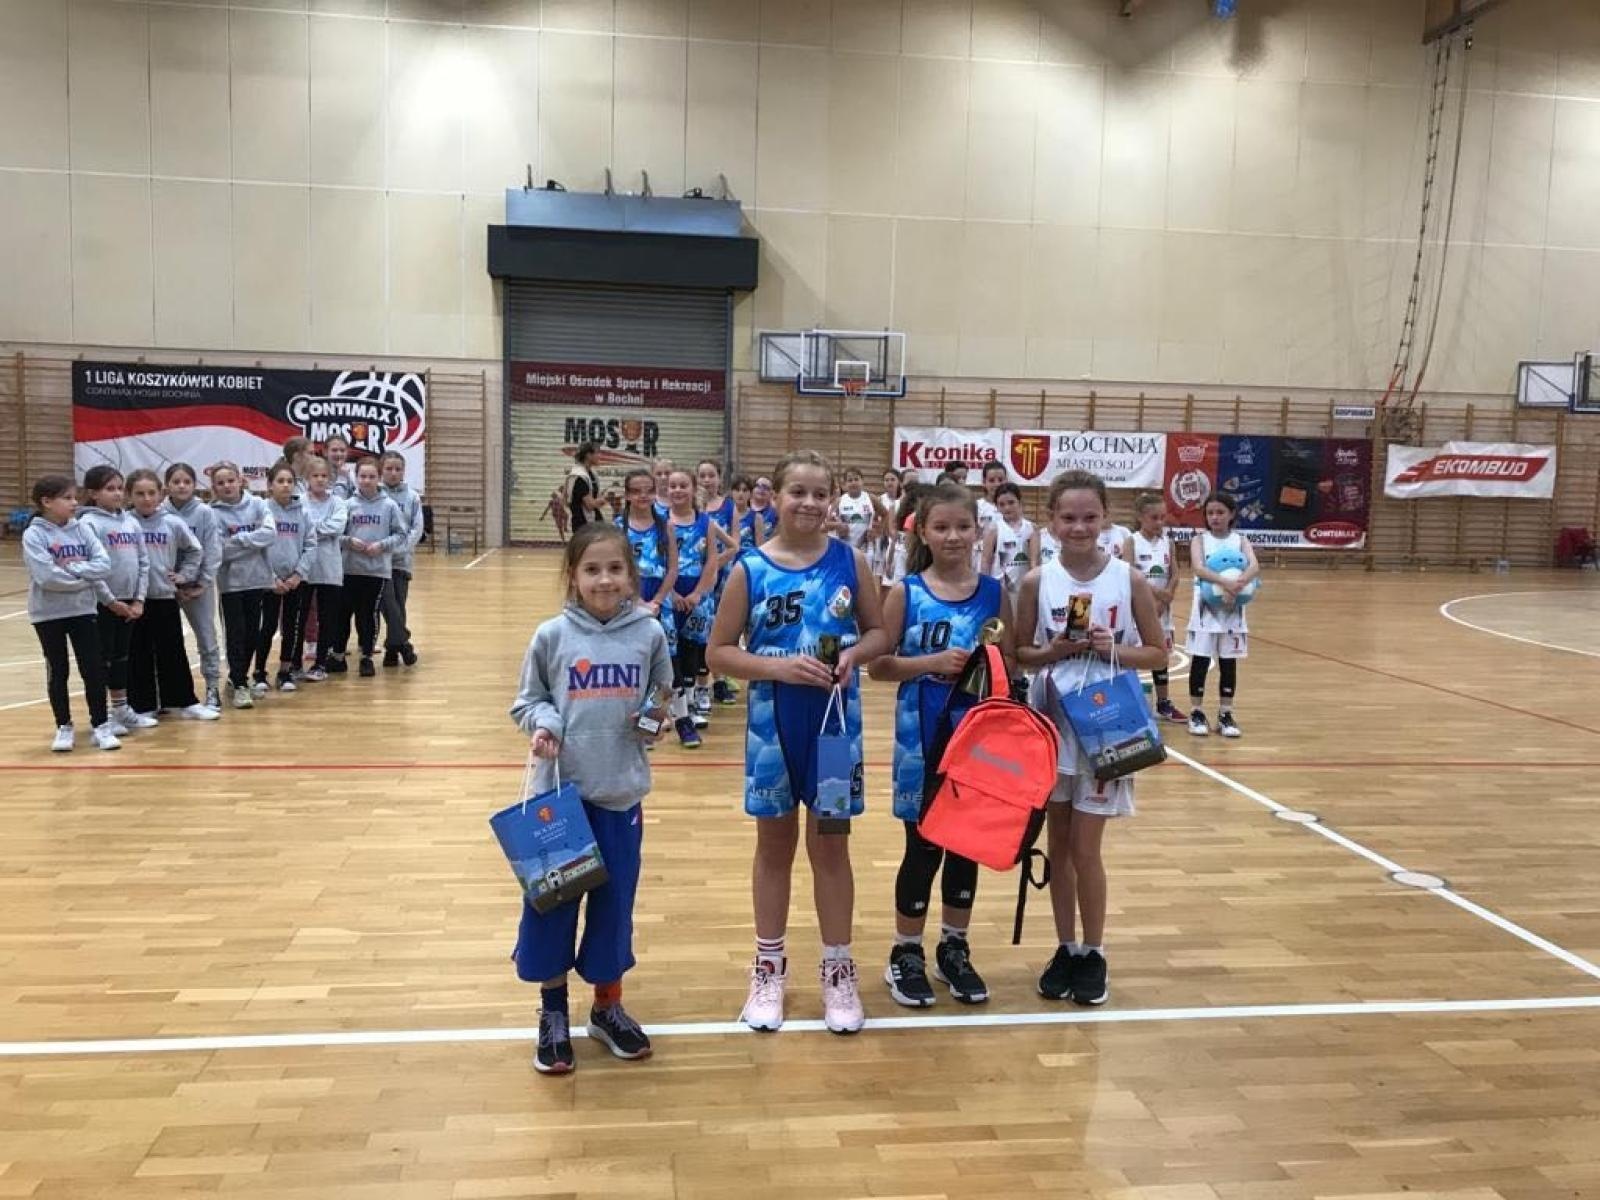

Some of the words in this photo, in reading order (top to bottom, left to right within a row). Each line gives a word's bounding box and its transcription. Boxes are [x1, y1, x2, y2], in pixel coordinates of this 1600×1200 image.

[85, 370, 92, 384] 1
[96, 371, 125, 385] LIGA
[127, 370, 214, 389] KOSZYKÓWKI
[218, 375, 264, 390] KOBIET
[526, 372, 566, 387] Miejski
[569, 374, 612, 388] Ośrodek
[661, 379, 712, 395] Rekreacji
[595, 393, 604, 403] w
[607, 392, 645, 405] Bochni
[293, 400, 392, 423] CONTIMAX
[899, 441, 996, 468] Kronika
[1058, 435, 1160, 454] BOCHNIA
[1056, 458, 1103, 470] MIASTO
[1106, 460, 1134, 470] SOLI
[1433, 460, 1529, 476] EKOMBUD
[144, 532, 168, 545] INI
[765, 590, 806, 630] 35
[1107, 605, 1118, 629] 1
[919, 621, 953, 650] 10
[568, 663, 641, 690] MINI
